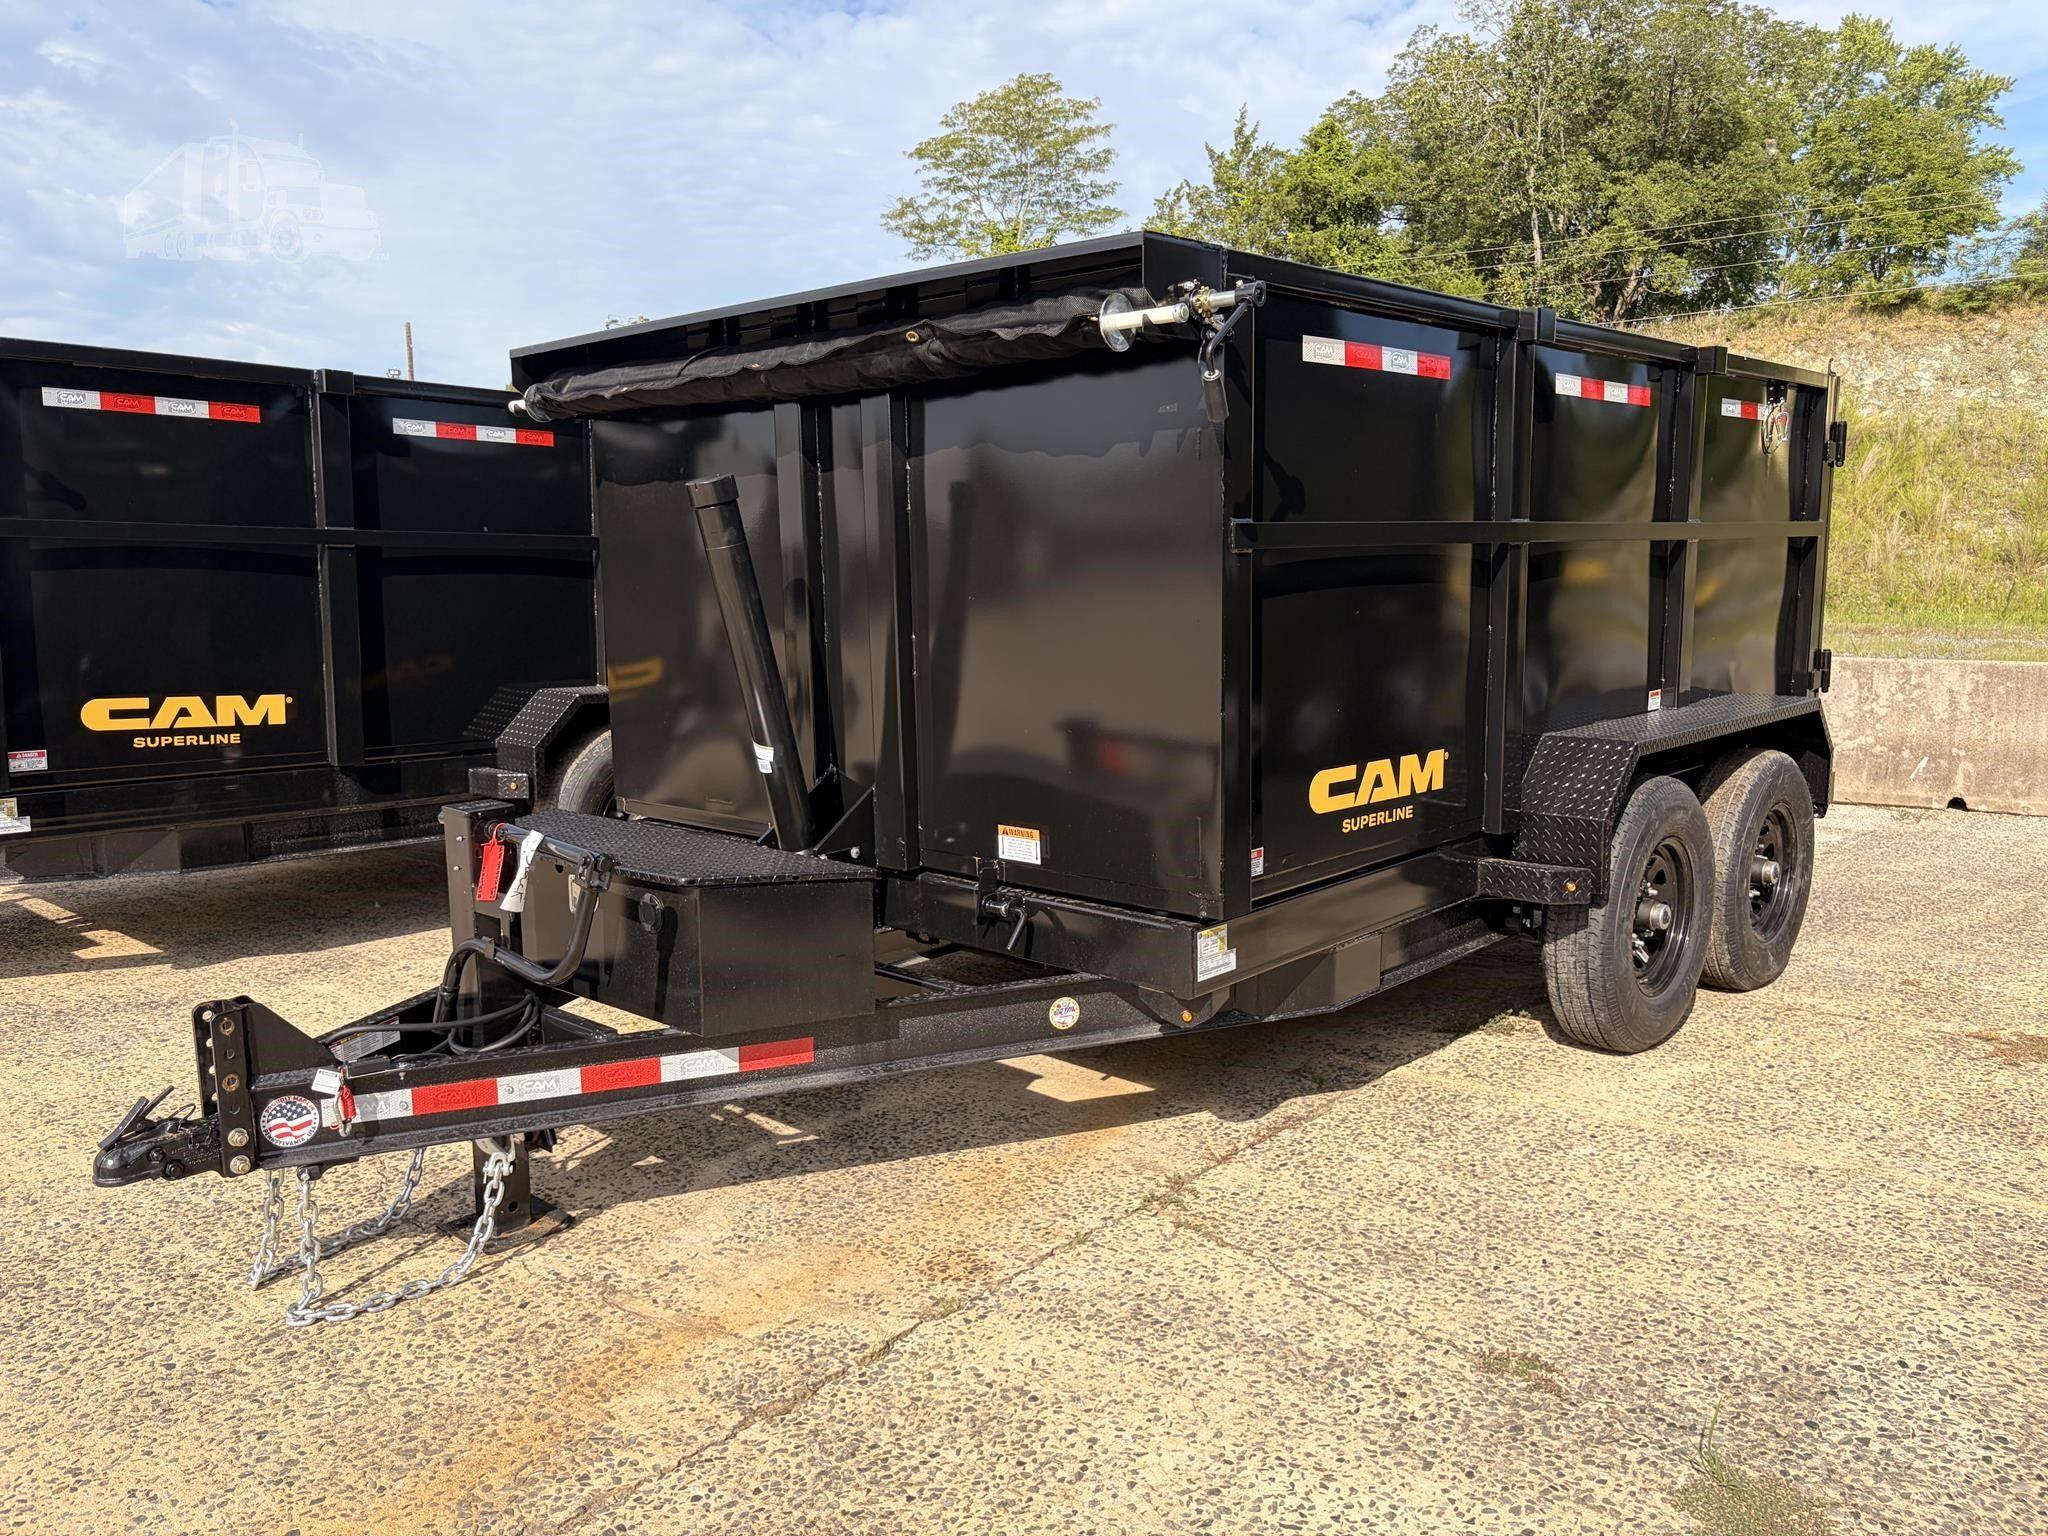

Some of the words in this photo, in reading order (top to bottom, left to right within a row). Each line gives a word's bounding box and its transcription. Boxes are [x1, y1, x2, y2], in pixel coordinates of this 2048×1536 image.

[1315, 343, 1333, 355] CAM
[58, 393, 84, 404] CAM
[116, 398, 139, 407] CAM
[169, 402, 193, 412] CAM
[406, 423, 424, 432] CAM
[488, 430, 504, 438] CAM
[133, 733, 241, 749] SUPERLINE
[1342, 805, 1414, 833] SUPERLINE
[1009, 828, 1034, 838] WARNING
[684, 1058, 718, 1072] CAM
[605, 1069, 639, 1082] CAM
[522, 1079, 556, 1093] CAM
[438, 1088, 474, 1103] CAM
[265, 1096, 291, 1113] PROUDLY
[293, 1095, 310, 1105] MADE
